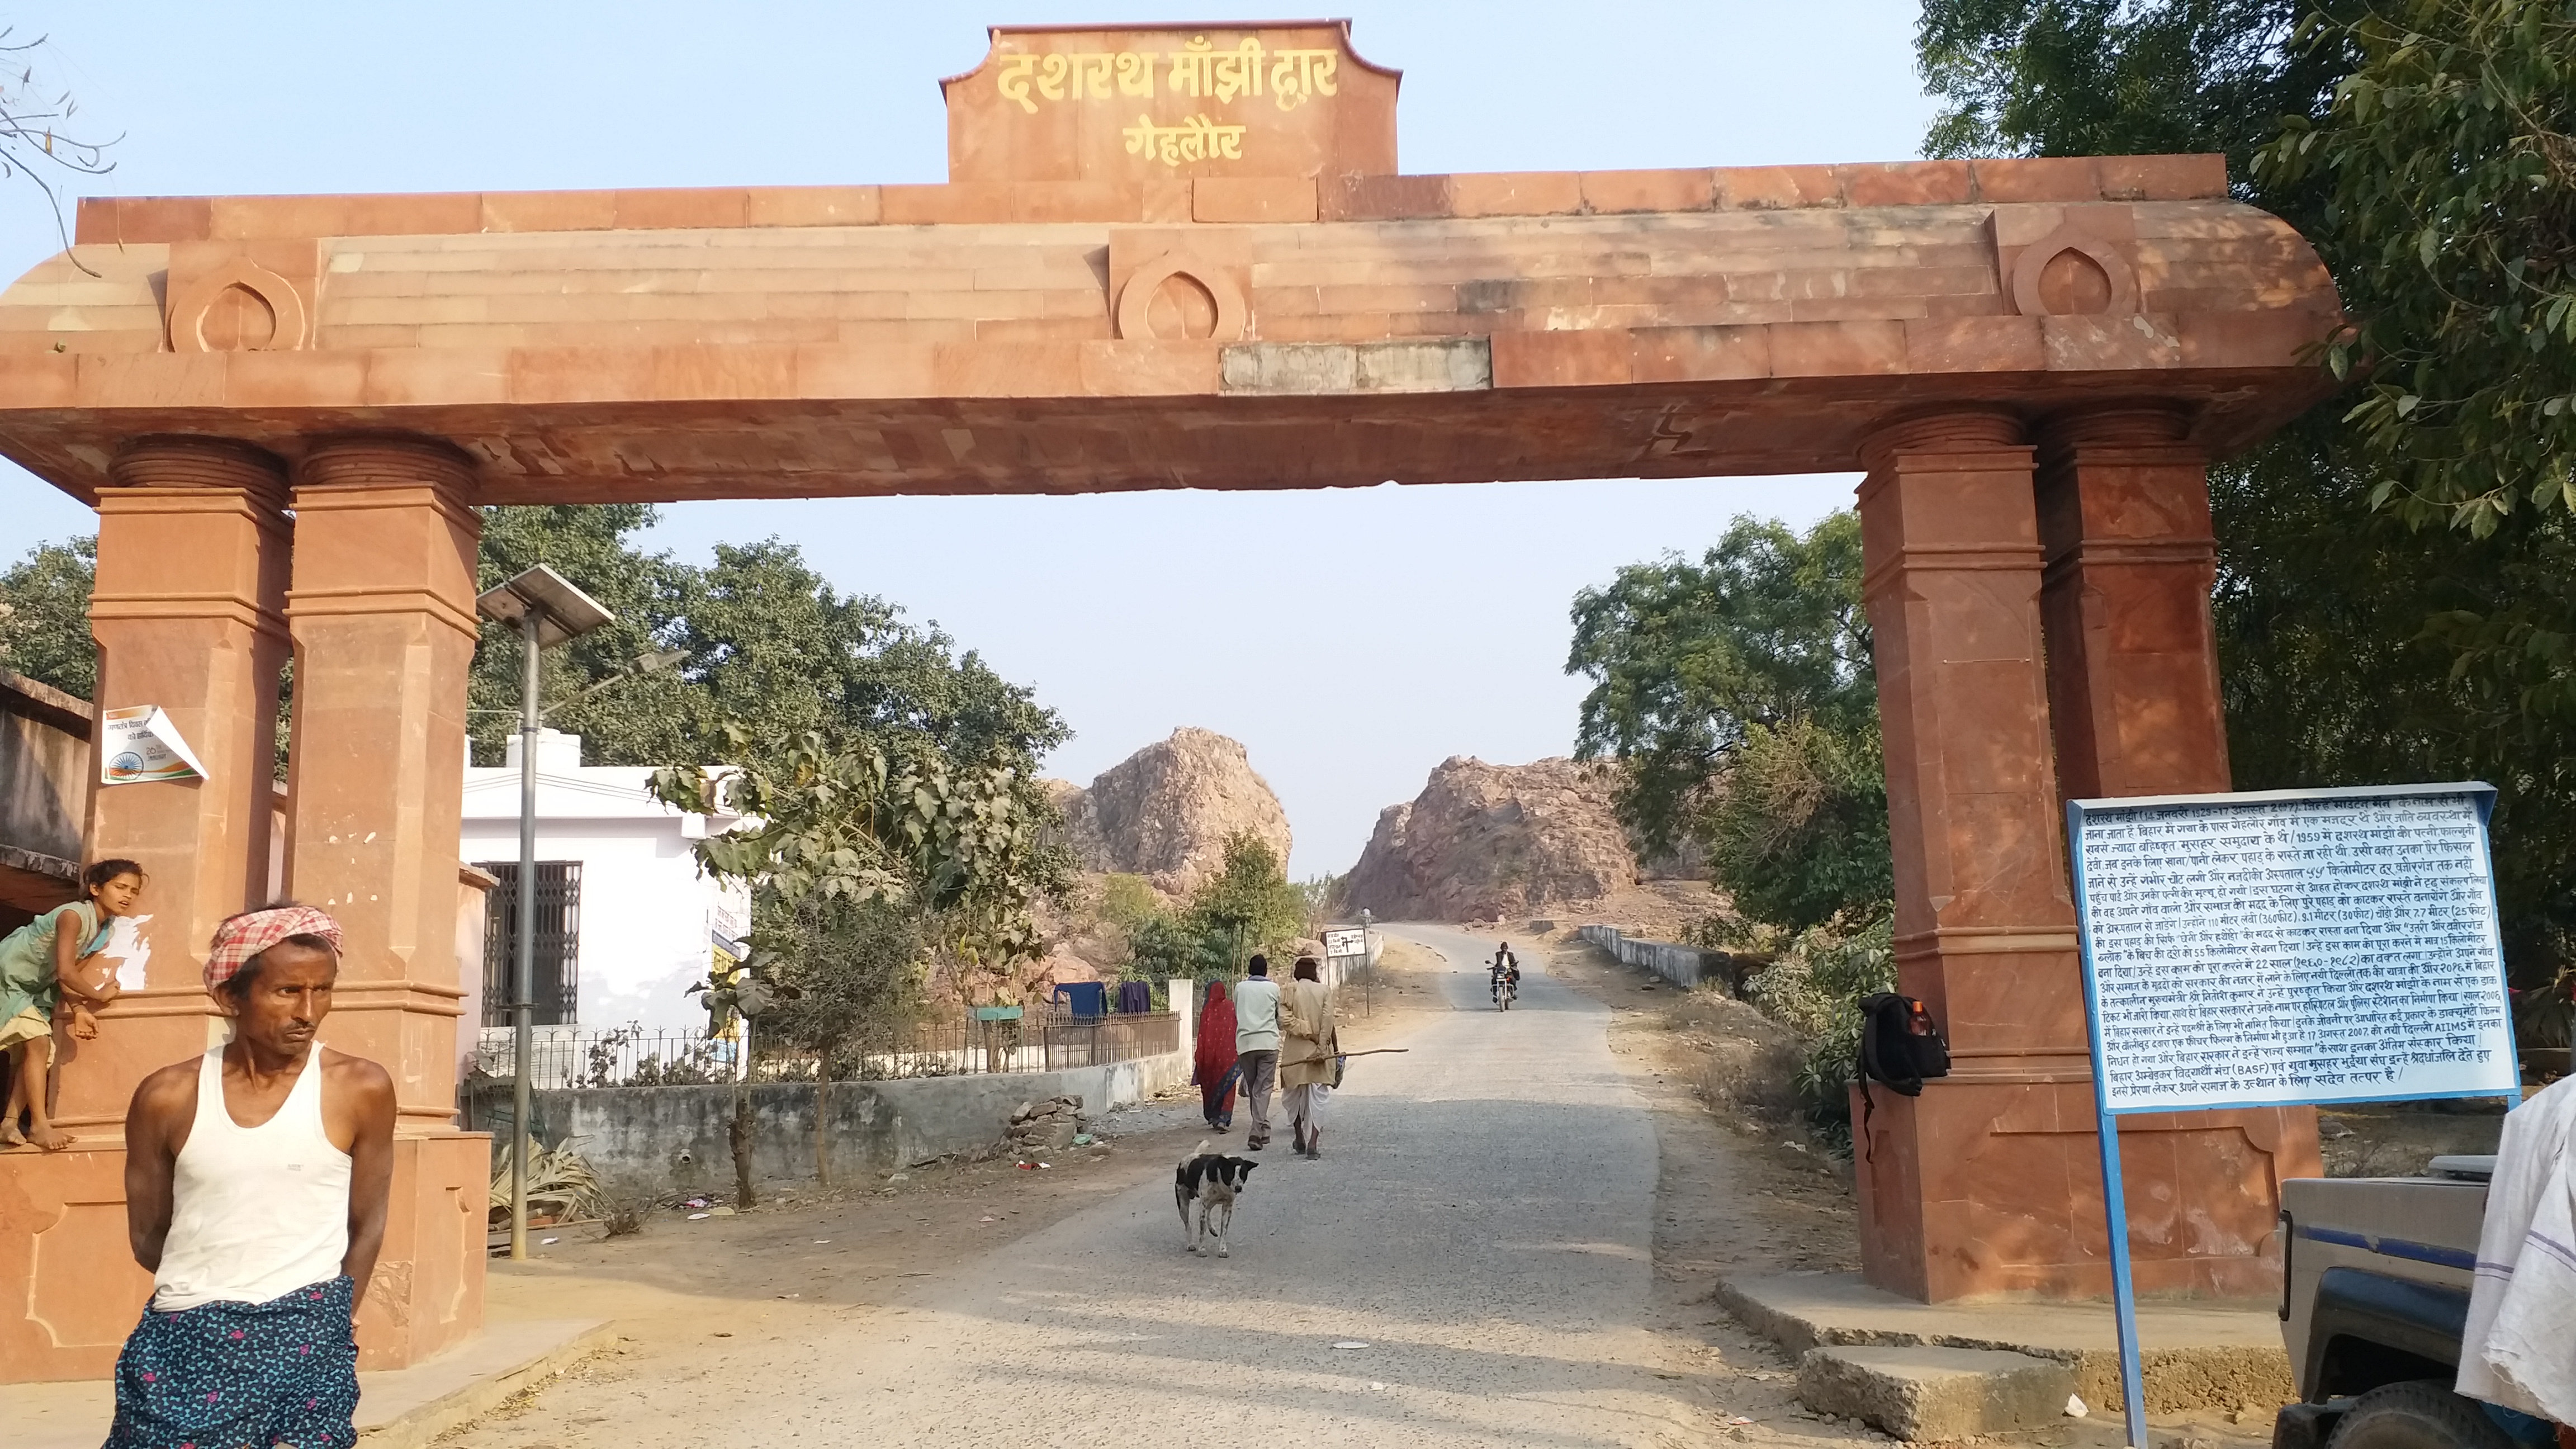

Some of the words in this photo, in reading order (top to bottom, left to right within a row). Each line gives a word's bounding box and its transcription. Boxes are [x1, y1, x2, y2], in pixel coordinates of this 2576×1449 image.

[998, 51, 1159, 113] दशरथ
[1167, 36, 1267, 104] माँझी
[1271, 49, 1338, 111] द्वार
[1123, 113, 1247, 167] गेहलौर
[146, 746, 156, 755] 26
[2085, 828, 2106, 840] जाना
[2106, 828, 2126, 840] जाता
[2136, 824, 2163, 837] बिहार
[2176, 824, 2199, 833] गया
[2209, 822, 2230, 832] पास
[2319, 815, 2358, 827] मजदूर
[2416, 809, 2463, 822] व्यवस्था
[2085, 841, 2110, 856] सबसे
[2111, 842, 2137, 853] ज्यादा
[2178, 837, 2217, 853] मुसहर
[2219, 835, 2262, 849] समुदाय
[2296, 832, 2321, 843] 1959
[2321, 827, 2333, 842] में
[2334, 828, 2369, 842] दशरथ
[2120, 855, 2142, 871] इनके
[2142, 854, 2164, 870] लिए
[2211, 850, 2239, 866] लेकर
[2277, 846, 2302, 862] रास्ते
[2315, 844, 2334, 860] रही
[2395, 844, 2424, 856] उनका
[2438, 839, 2475, 854] फिसल
[2088, 873, 2106, 889] जाने
[2119, 872, 2138, 889] उन्हें
[2167, 871, 2185, 885] चोट
[2265, 868, 2305, 881] अस्पताल
[2326, 860, 2378, 877] किलोमीटर
[2161, 886, 2180, 900] पत्नी
[2269, 884, 2294, 894] घटना
[2332, 878, 2361, 893] होकर
[2105, 922, 2143, 935] अस्पताल
[2219, 913, 2240, 926] मीटर
[2313, 906, 2337, 922] मीटर
[2427, 903, 2451, 918] मीटर
[2116, 903, 2140, 917] अपने
[2203, 902, 2233, 913] समाज
[2247, 899, 2269, 911] मदद
[2278, 894, 2300, 910] लिए
[2352, 894, 2386, 906] काटकर
[2108, 939, 2123, 949] इस
[2255, 930, 2274, 939] मदद
[2285, 927, 2318, 937] काटकर
[2318, 926, 2343, 937] रास्ता
[2359, 921, 2383, 936] दिया
[2194, 949, 2205, 958] 55
[2205, 943, 2249, 957] किलोमीटर
[2277, 940, 2301, 953] दिया
[2324, 941, 2341, 953] इस
[2341, 940, 2362, 951] काम
[2391, 934, 2413, 949] करने
[2171, 964, 2192, 975] काम
[2192, 960, 2206, 973] को
[2222, 958, 2244, 972] करने
[2256, 959, 2269, 969] 22
[2269, 958, 2293, 969] साल
[2455, 944, 2477, 958] अपने
[2116, 982, 2141, 994] समाज
[2185, 977, 2218, 989] सरकार
[2232, 976, 2255, 986] नजर
[2329, 966, 2356, 981] दिल्ली
[2386, 967, 2408, 976] यात्रा
[2473, 958, 2495, 971] बिहार
[2229, 989, 2257, 1003] कुमार
[2321, 981, 2347, 993] किया
[2365, 979, 2395, 993] दशरथ
[2432, 978, 2453, 987] नाम
[2479, 976, 2497, 986] डाक
[2101, 1010, 2121, 1024] टिकट
[2198, 1003, 2220, 1019] बिहार
[2219, 1005, 2248, 1017] सरकार
[2255, 1000, 2274, 1014] उनके
[2349, 995, 2372, 1012] पुलिस
[2409, 990, 2437, 1006] निर्माण
[2436, 989, 2460, 1004] किया
[2111, 1024, 2131, 1039] बिहार
[2132, 1026, 2157, 1037] सरकार
[2268, 1015, 2292, 1029] किया
[2316, 1011, 2343, 1026] जीवनी
[2354, 1010, 2388, 1024] आधारित
[2389, 1008, 2404, 1022] कई
[2402, 1010, 2427, 1022] प्रकार
[2184, 1035, 2209, 1048] फीचर
[2208, 1033, 2234, 1046] फिल्म
[2242, 1030, 2270, 1043] निर्माण
[2307, 1031, 2316, 1040] 17
[2317, 1029, 2347, 1040] अगस्त
[2401, 1020, 2435, 1035] दिल्ली
[2435, 1021, 2467, 1033] AIIMS
[2476, 1018, 2503, 1031] इनका
[2106, 1054, 2130, 1068] निधन
[2141, 1055, 2156, 1064] गया
[2175, 1050, 2200, 1064] बिहार
[2200, 1050, 2231, 1063] सरकार
[2327, 1043, 2349, 1054] साथ
[2350, 1042, 2378, 1054] इनका
[2378, 1037, 2407, 1051] अंतिम
[2407, 1036, 2444, 1050] संस्कार
[2445, 1032, 2476, 1046] किया
[2109, 1069, 2134, 1086] बिहार
[2213, 1063, 2231, 1076] मंच
[2232, 1062, 2269, 1076] (BASF)
[2288, 1060, 2309, 1074] युवा
[2308, 1058, 2340, 1072] मुसहर
[2457, 1046, 2475, 1062] देते
[2476, 1045, 2492, 1063] हुए
[2111, 1086, 2129, 1098] इनसे
[2129, 1083, 2151, 1096] प्रेरणा
[2152, 1081, 2179, 1096] लेकर
[2179, 1079, 2200, 1093] अपने
[2200, 1081, 2229, 1093] समाज
[2243, 1077, 2277, 1090] उत्थान
[2288, 1073, 2312, 1088] लिए
[2350, 1071, 2383, 1085] तत्पर
